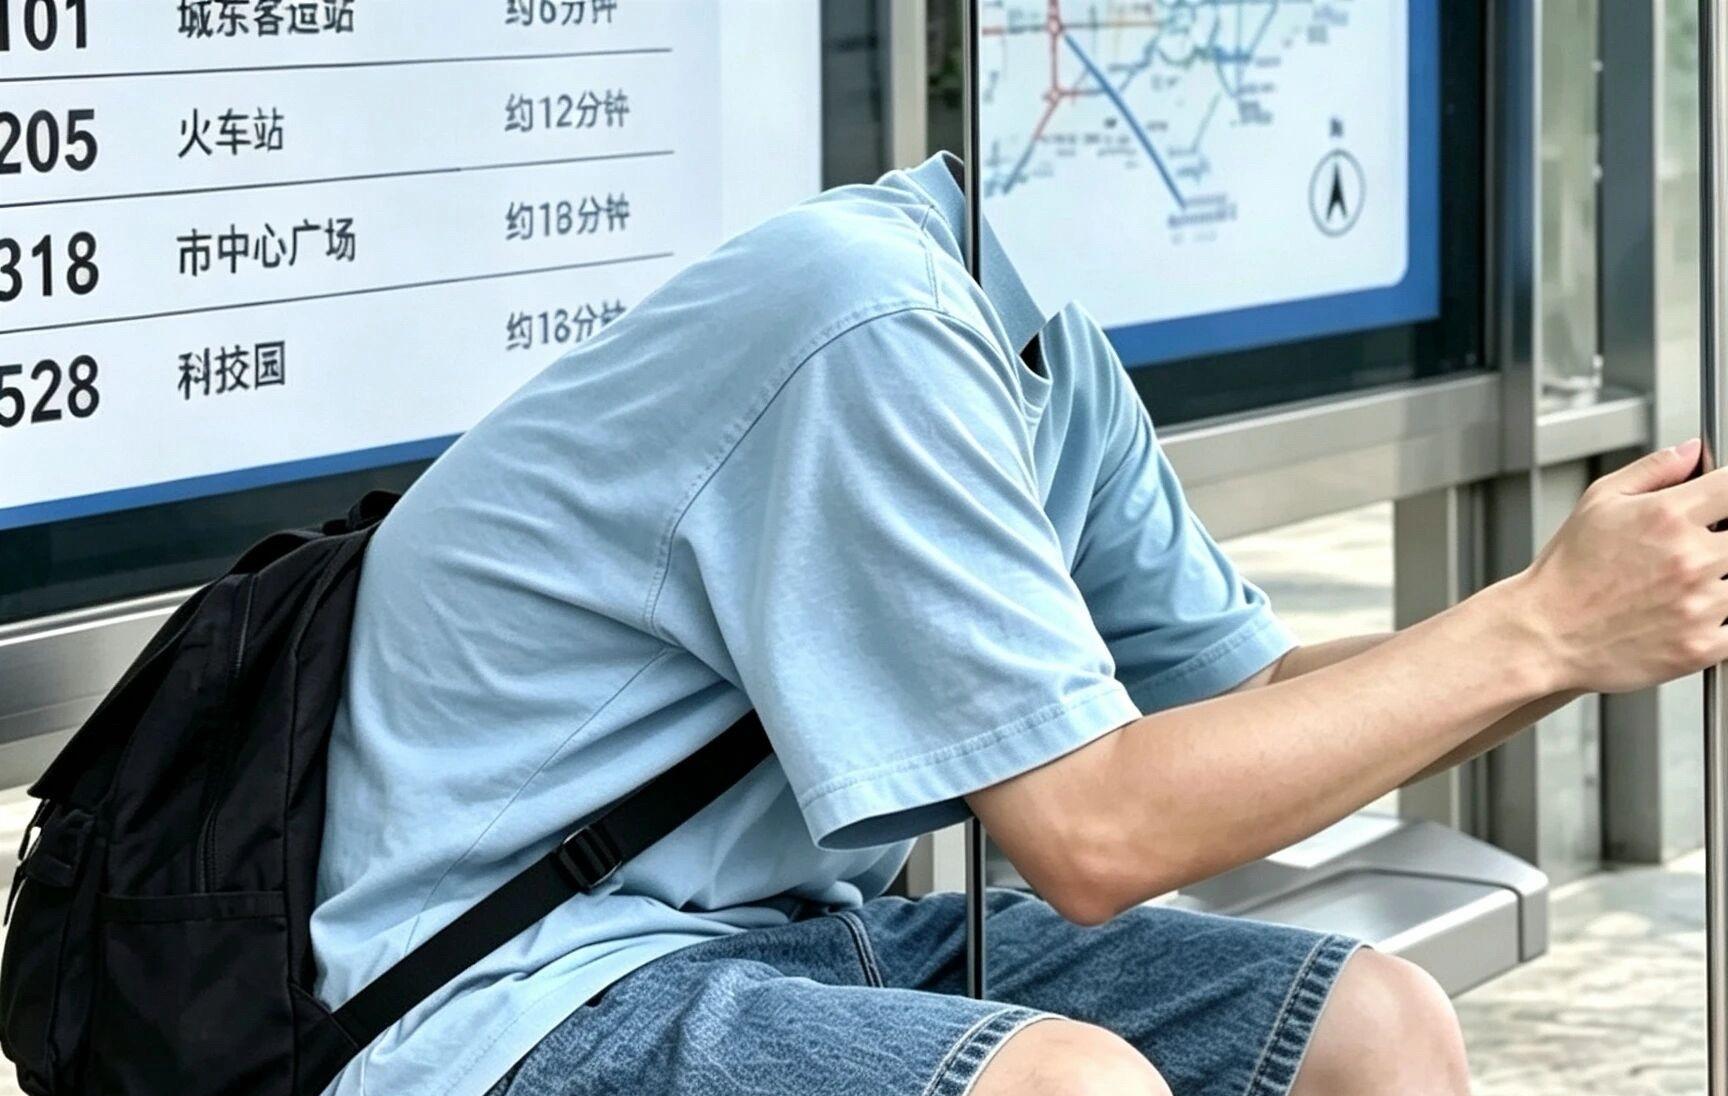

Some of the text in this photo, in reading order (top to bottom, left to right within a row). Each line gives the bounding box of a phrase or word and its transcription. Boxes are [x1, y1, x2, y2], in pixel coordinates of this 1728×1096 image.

[0, 89, 630, 176] 205 火车站 约12分钟
[0, 231, 99, 302] 318
[176, 218, 356, 277] 市中心广场
[0, 355, 100, 428] 528
[178, 340, 286, 400] 科技园
